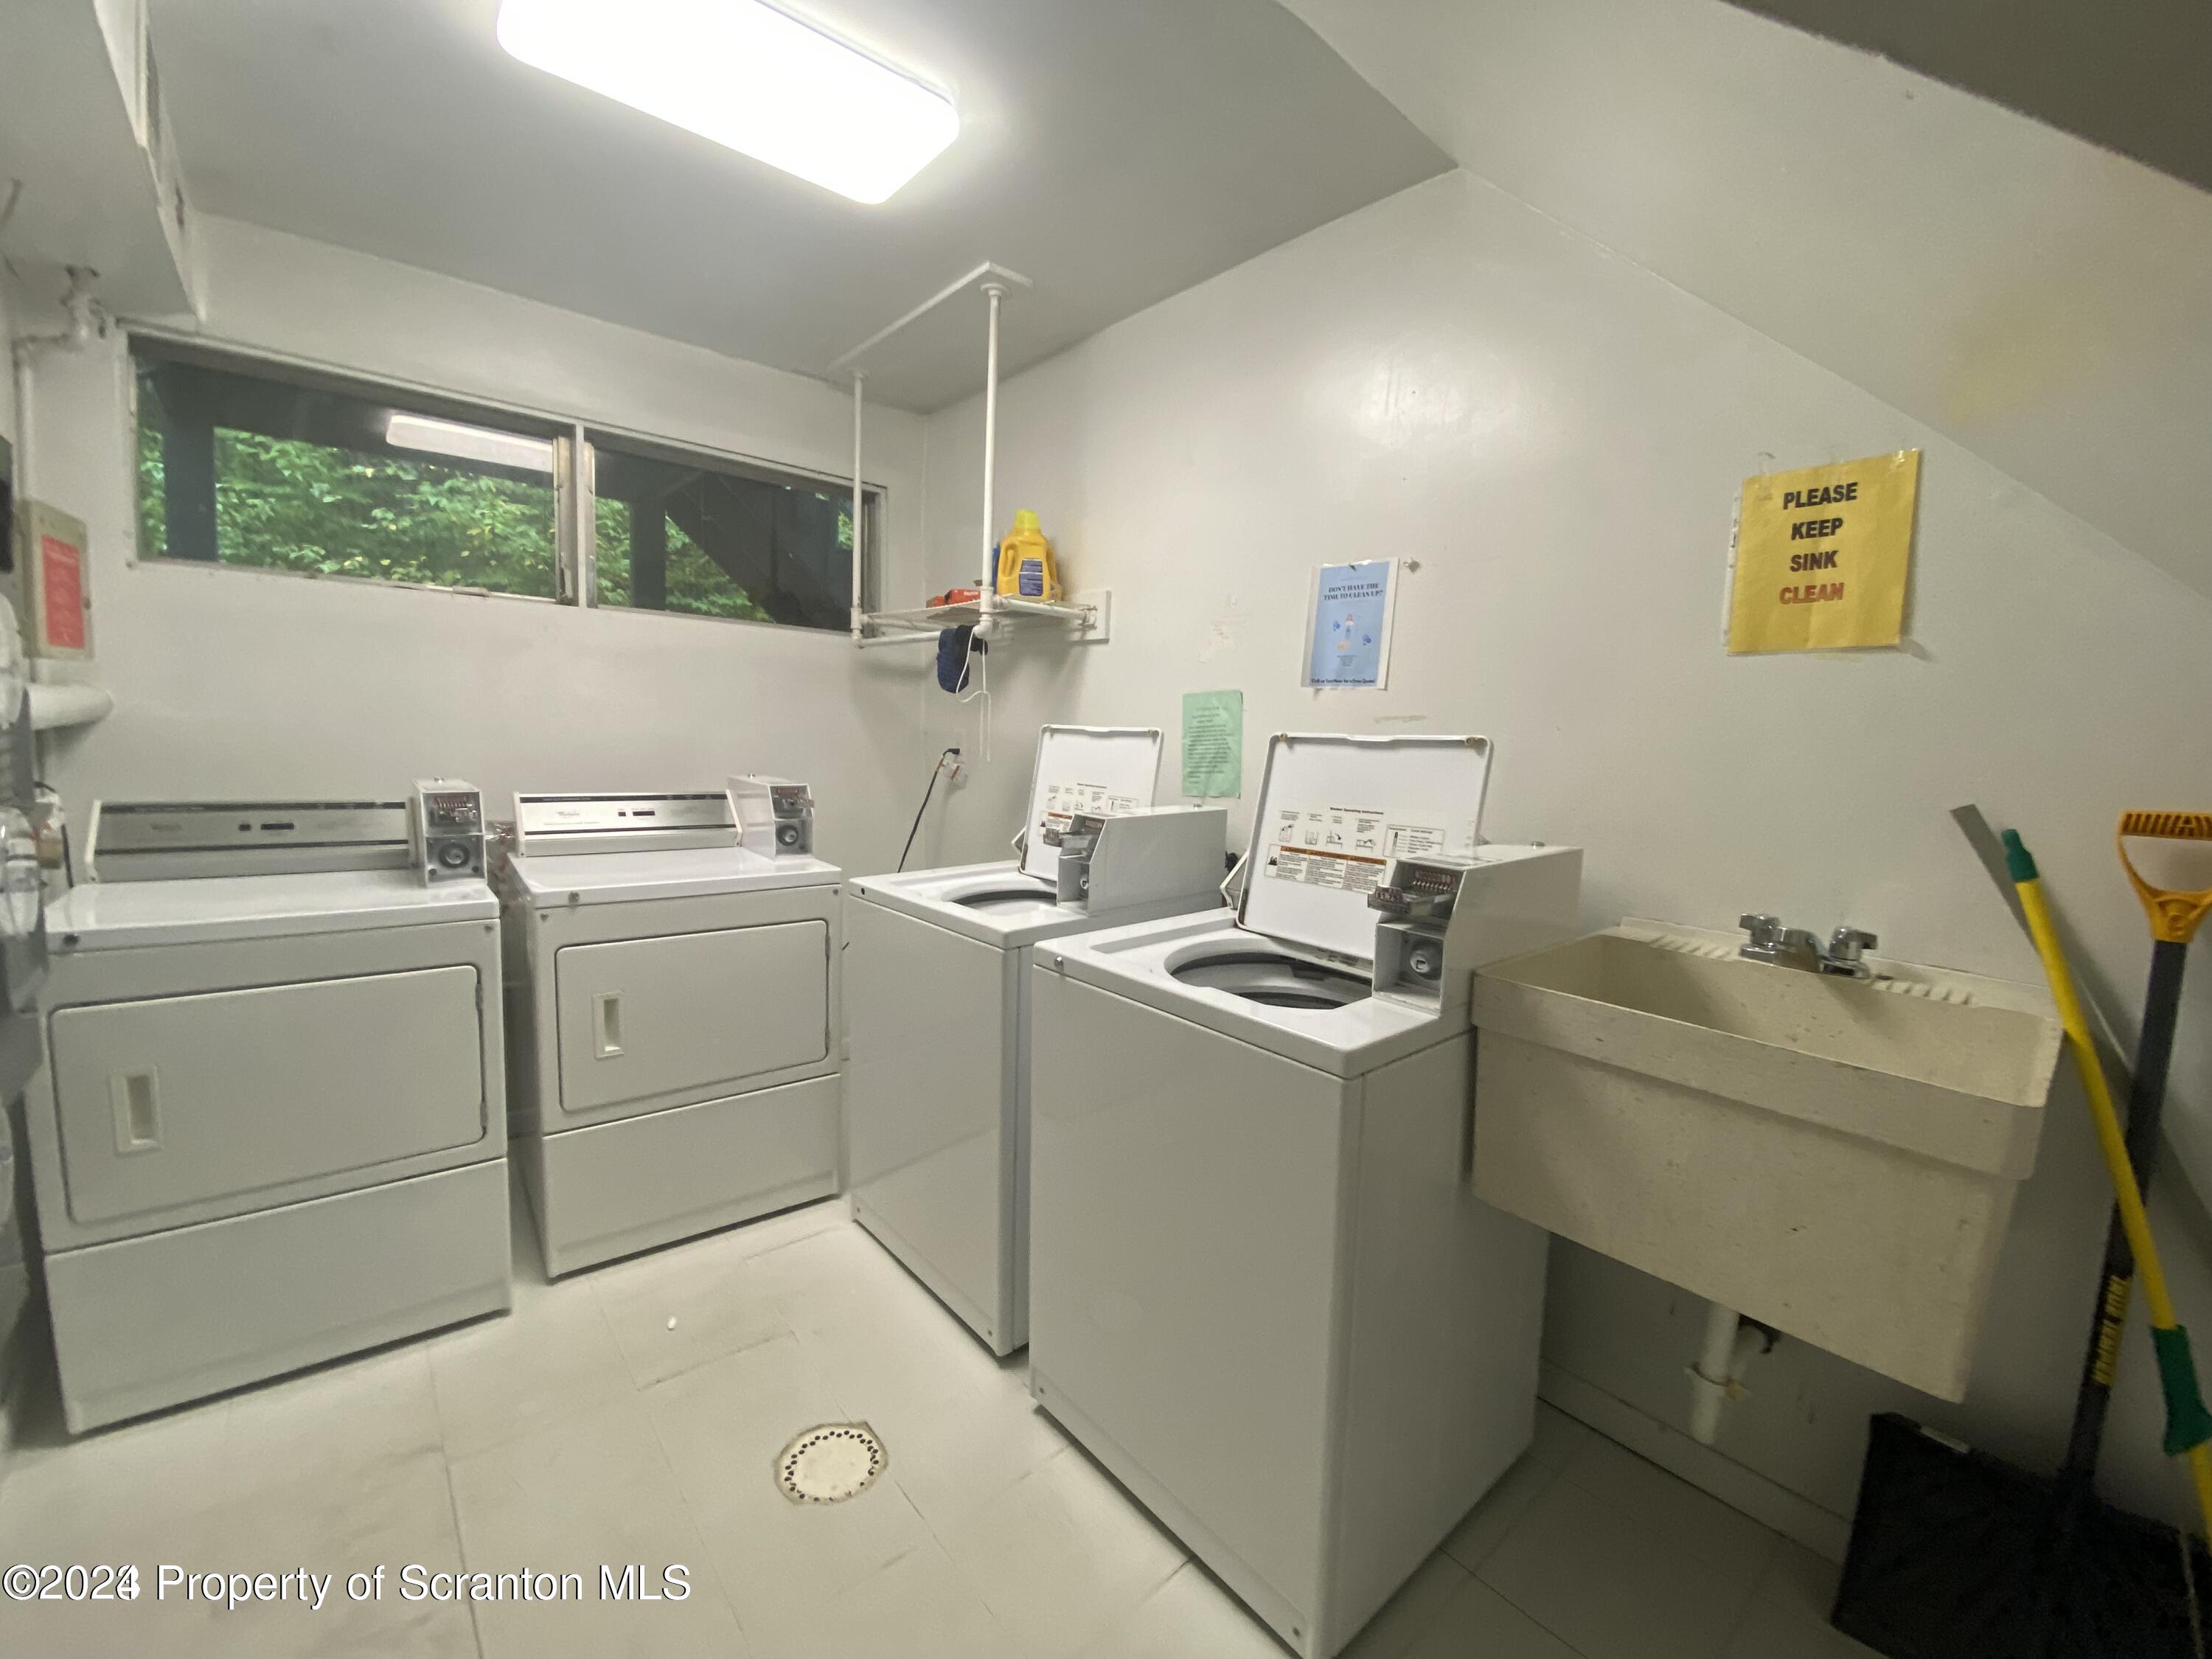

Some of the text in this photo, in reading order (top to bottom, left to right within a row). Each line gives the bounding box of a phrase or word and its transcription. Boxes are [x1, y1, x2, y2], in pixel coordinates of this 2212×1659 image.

[1783, 482, 1858, 509] PLEASE
[1791, 518, 1843, 540] KEEP
[1790, 550, 1838, 572] SINK
[1779, 582, 1844, 605] CLEAN
